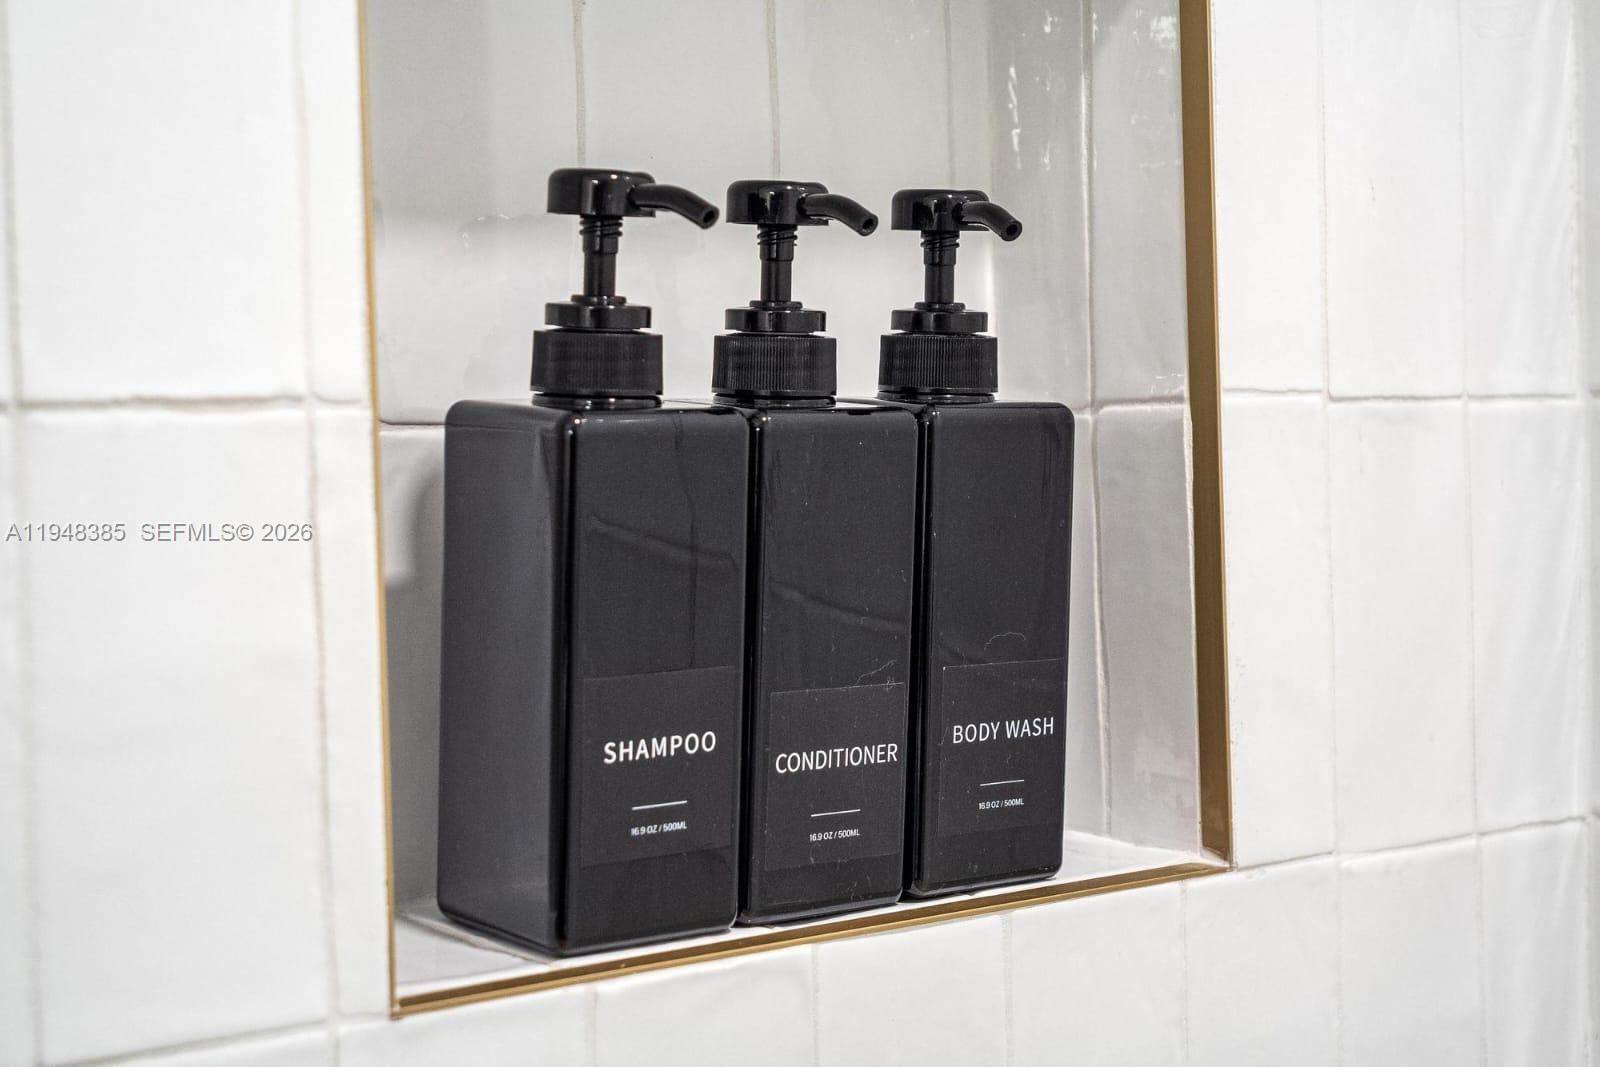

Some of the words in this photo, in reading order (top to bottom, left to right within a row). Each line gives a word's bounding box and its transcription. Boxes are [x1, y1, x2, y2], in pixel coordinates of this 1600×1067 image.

[953, 721, 1000, 744] BODY
[1005, 717, 1054, 739] WASH
[603, 731, 717, 764] SHAMPOO
[775, 743, 898, 774] CONDITIONER
[991, 800, 1000, 809] OZ
[1004, 798, 1025, 808] 500ML
[646, 824, 658, 834] OZ
[663, 821, 688, 832] 500ML
[823, 831, 833, 840] OZ
[838, 828, 861, 839] 500ML
